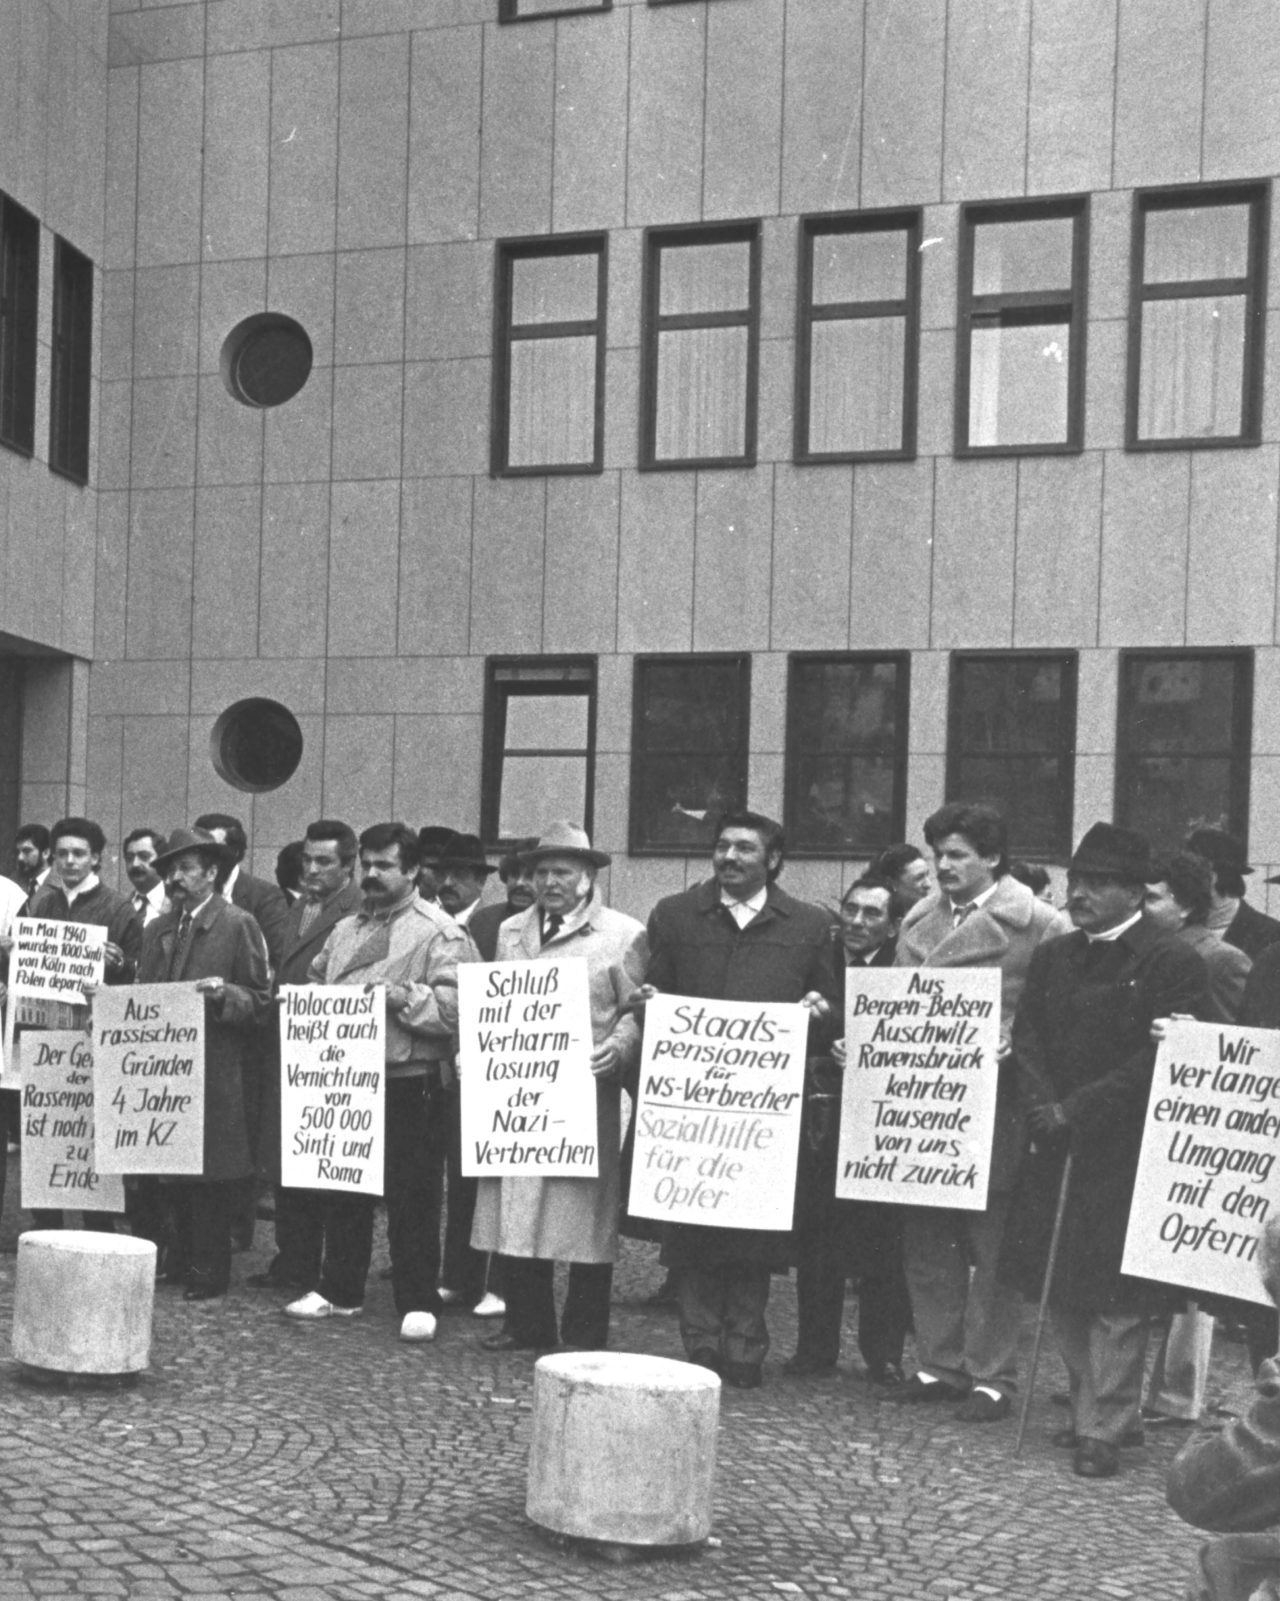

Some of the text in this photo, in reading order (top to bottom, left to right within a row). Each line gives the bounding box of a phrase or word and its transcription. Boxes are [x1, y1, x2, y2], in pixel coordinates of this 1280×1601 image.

[19, 922, 86, 943] Im Mai 1940
[18, 939, 102, 962] wurden 1000 Sinti
[16, 970, 45, 987] Polen
[18, 955, 94, 977] von Köln nach
[486, 967, 559, 998] Schluß
[908, 972, 944, 995] Aus
[124, 997, 160, 1021] Aus
[287, 992, 375, 1015] Holocaust
[479, 999, 561, 1023] mit der
[853, 993, 993, 1020] Bergen-Belsen
[100, 1022, 198, 1046] rassischen
[287, 1018, 378, 1044] heißt auch
[670, 1005, 790, 1042] Staats-
[871, 1018, 979, 1045] Auschwitz
[478, 1028, 580, 1052] Verharm-
[1219, 1033, 1260, 1065] Wir
[34, 1043, 67, 1066] Der
[121, 1051, 193, 1076] Gründen
[319, 1045, 345, 1062] die
[652, 1040, 790, 1070] pensionen
[858, 1044, 984, 1070] Ravensbrück
[66, 1072, 90, 1084] der
[287, 1063, 379, 1094] Vernichtung
[486, 1057, 560, 1083] losung
[705, 1065, 736, 1080] für
[24, 1084, 94, 1111] Rassenpo
[112, 1086, 192, 1114] 4 Jahre
[325, 1093, 351, 1106] von
[507, 1087, 544, 1108] der
[646, 1075, 800, 1111] NS-Verbrecher
[885, 1074, 967, 1102] kehrten
[300, 1106, 372, 1131] 500 000
[492, 1110, 566, 1132] Nazi-
[872, 1100, 971, 1132] Tausende
[1154, 1096, 1220, 1127] einen
[26, 1114, 47, 1137] ist
[52, 1116, 87, 1138] noch
[115, 1123, 137, 1149] im
[146, 1118, 178, 1146] KZ
[638, 1110, 774, 1151] Sozialhilfe
[66, 1145, 89, 1161] zu
[293, 1131, 374, 1160] Sinti und
[476, 1137, 595, 1165] Verbrechen
[874, 1134, 961, 1157] von uns
[1169, 1131, 1275, 1183] Umgang
[318, 1158, 363, 1184] Roma
[645, 1146, 743, 1180] für die
[844, 1156, 978, 1189] nicht zurück
[49, 1164, 99, 1190] Ende
[654, 1177, 729, 1210] Opfer
[1168, 1178, 1269, 1223] mit den
[1160, 1213, 1259, 1262] Opfern
